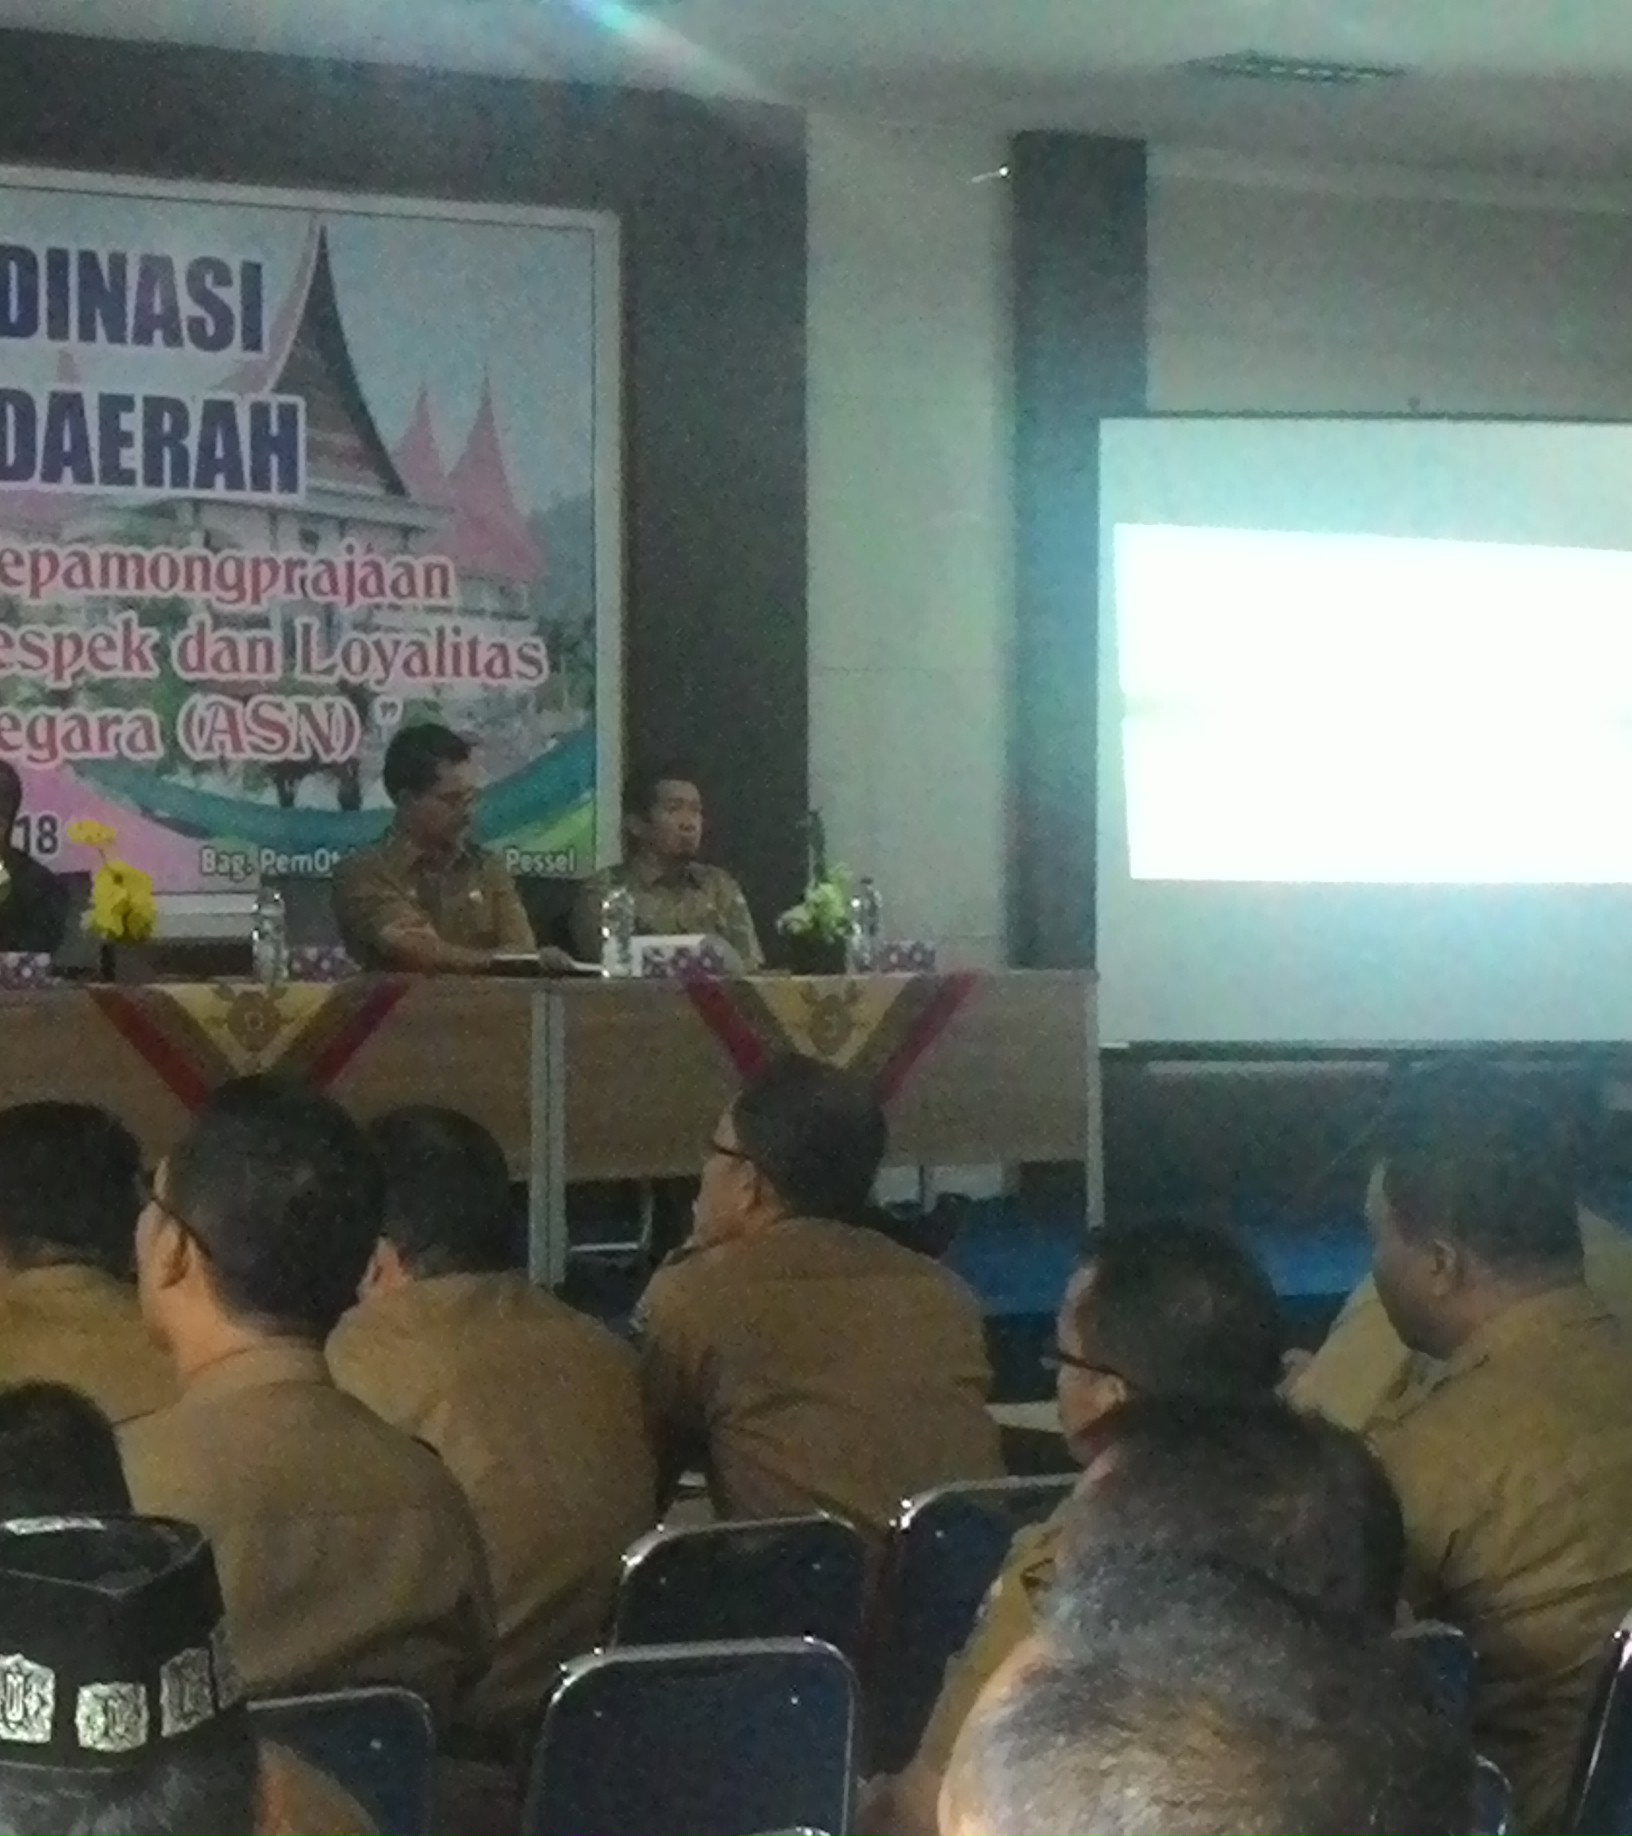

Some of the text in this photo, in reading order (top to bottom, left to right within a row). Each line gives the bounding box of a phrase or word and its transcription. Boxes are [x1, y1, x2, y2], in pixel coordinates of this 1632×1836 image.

[177, 618, 275, 676] dan
[299, 622, 545, 687] Loyalitas
[182, 697, 360, 760] (ASN)
[202, 847, 254, 882] Bag.
[505, 847, 574, 874] Pessel
